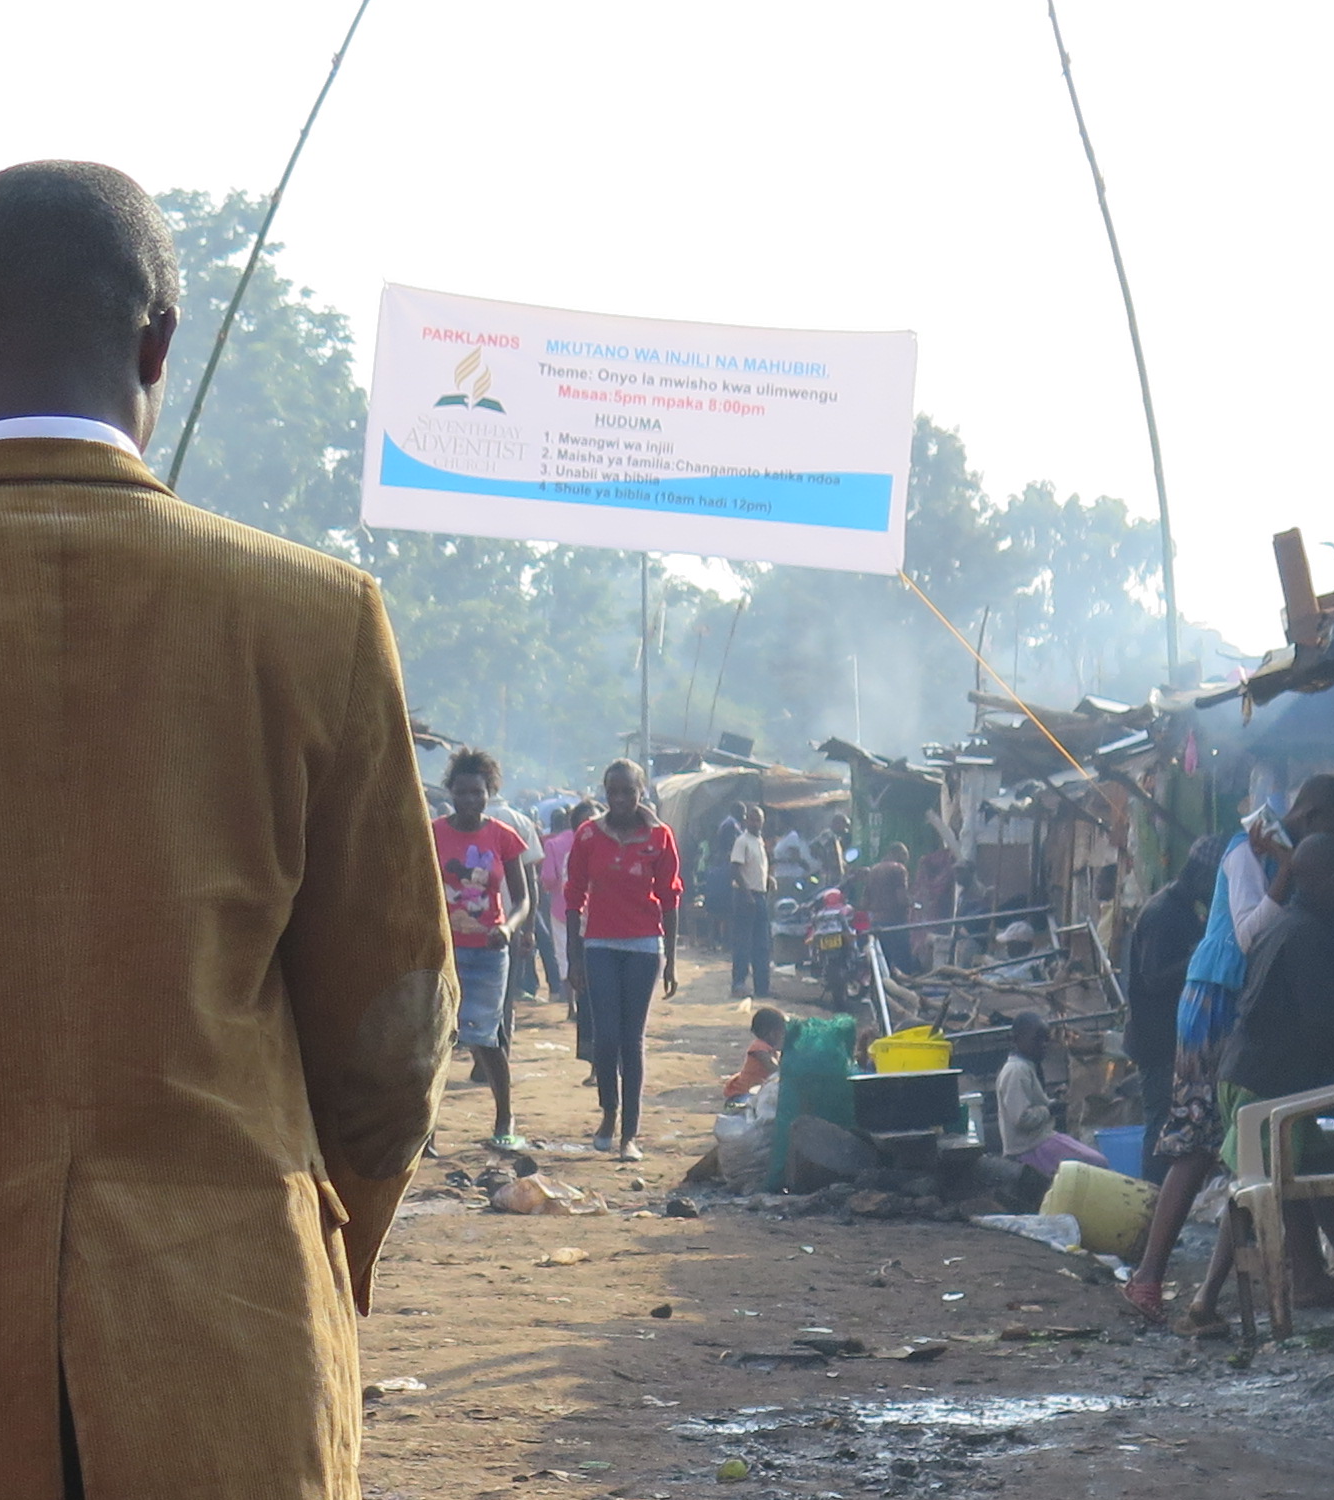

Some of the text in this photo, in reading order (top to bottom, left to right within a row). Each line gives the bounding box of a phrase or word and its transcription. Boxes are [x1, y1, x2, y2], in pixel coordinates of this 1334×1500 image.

[422, 327, 520, 350] PARKLANDS
[546, 339, 830, 378] MKUTANO WA INJILI NA MAHUBIRI.
[538, 362, 838, 404] Theme: Onyo la mwisho kwa ulimwengu
[652, 395, 703, 411] mpaka
[708, 398, 765, 417] 8:00pm
[417, 414, 523, 439] SEVENTH-DAY
[595, 413, 662, 432] HUDUMA
[401, 427, 529, 461] ADVENTIST
[544, 431, 674, 456] 1. Mwangwi wa injili
[433, 457, 496, 473] CHURCH
[540, 463, 660, 486] 3. Unabii wa biblia
[541, 447, 553, 460] 2.
[557, 448, 603, 464] Maisha
[607, 456, 623, 468] ya
[764, 467, 803, 483] katika
[807, 473, 841, 486] ndoa
[554, 481, 592, 495] Shule
[595, 488, 611, 500] ya
[614, 487, 651, 501] biblia
[654, 491, 695, 507] (10am
[699, 495, 727, 509] hadi
[733, 498, 772, 515] 12pm)
